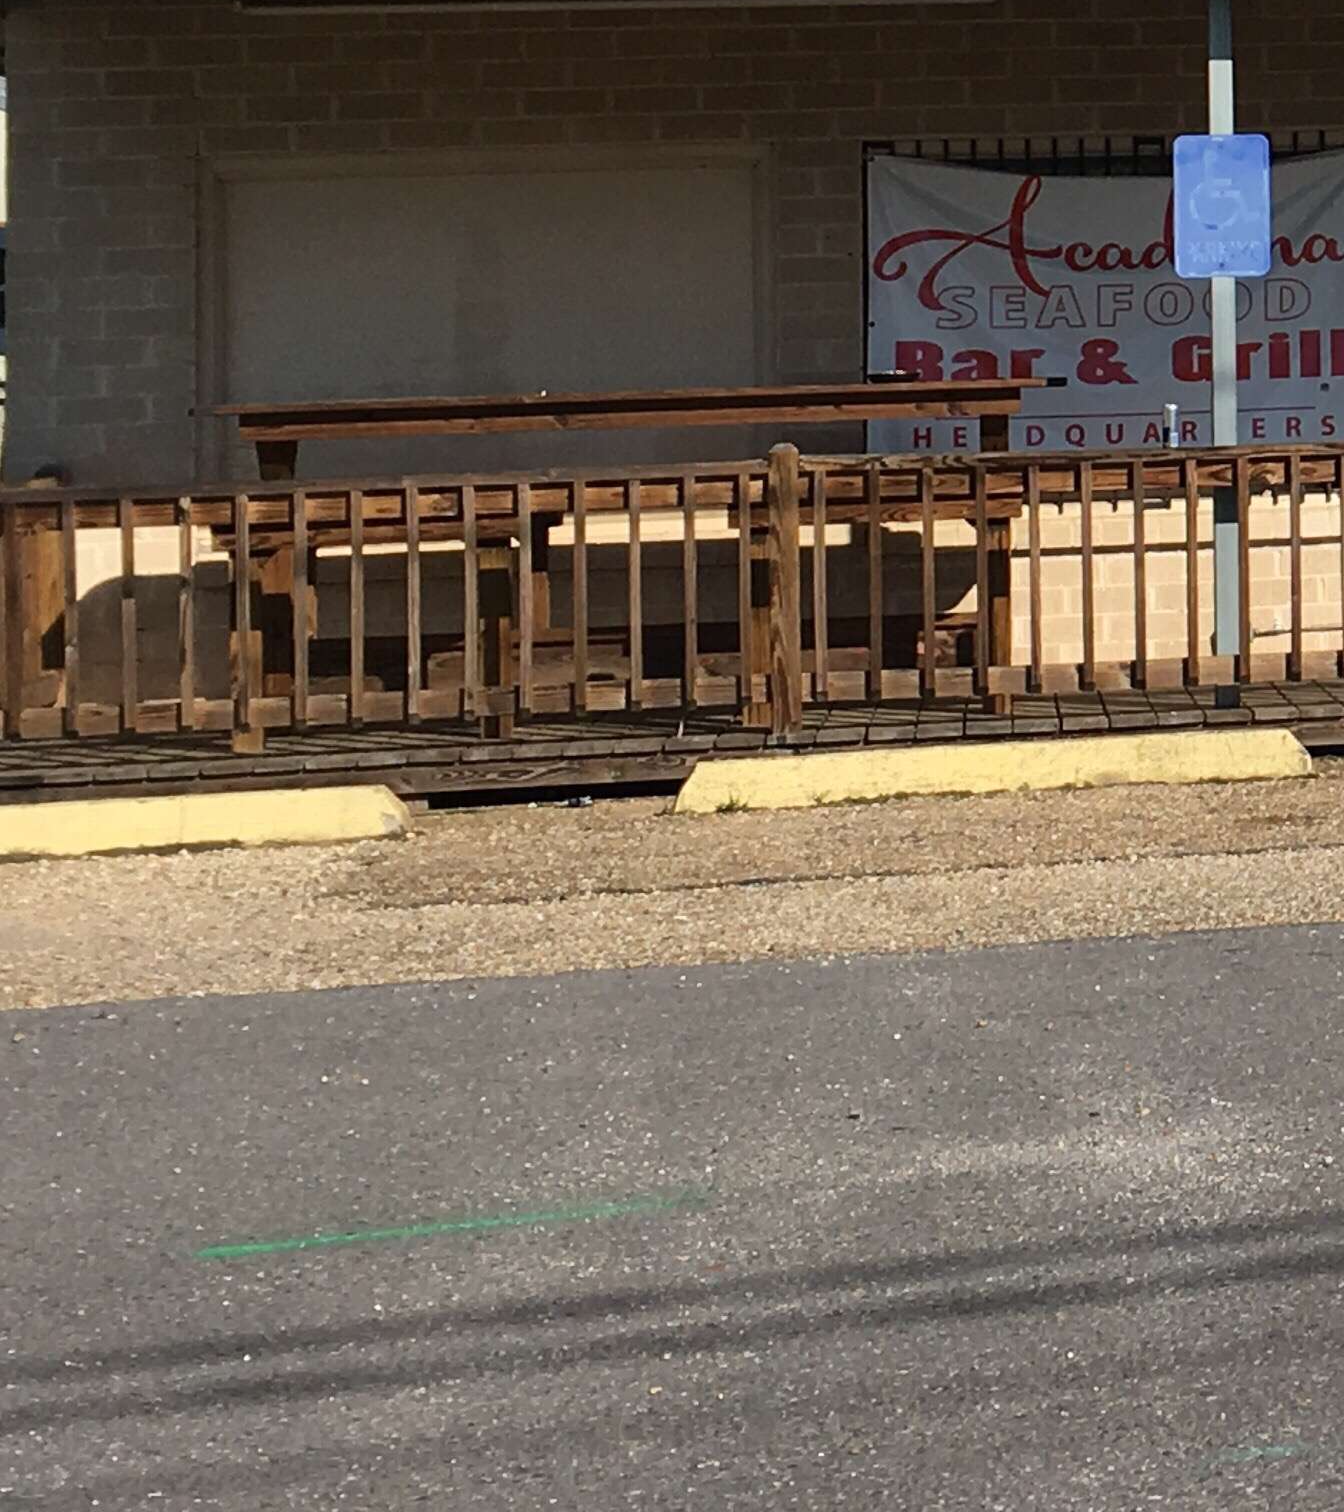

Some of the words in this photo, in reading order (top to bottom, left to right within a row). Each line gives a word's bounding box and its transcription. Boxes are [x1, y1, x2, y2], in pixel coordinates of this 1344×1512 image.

[895, 340, 1046, 380] Bar
[1075, 338, 1139, 385] &
[912, 414, 1336, 449] HEDQUARERS
